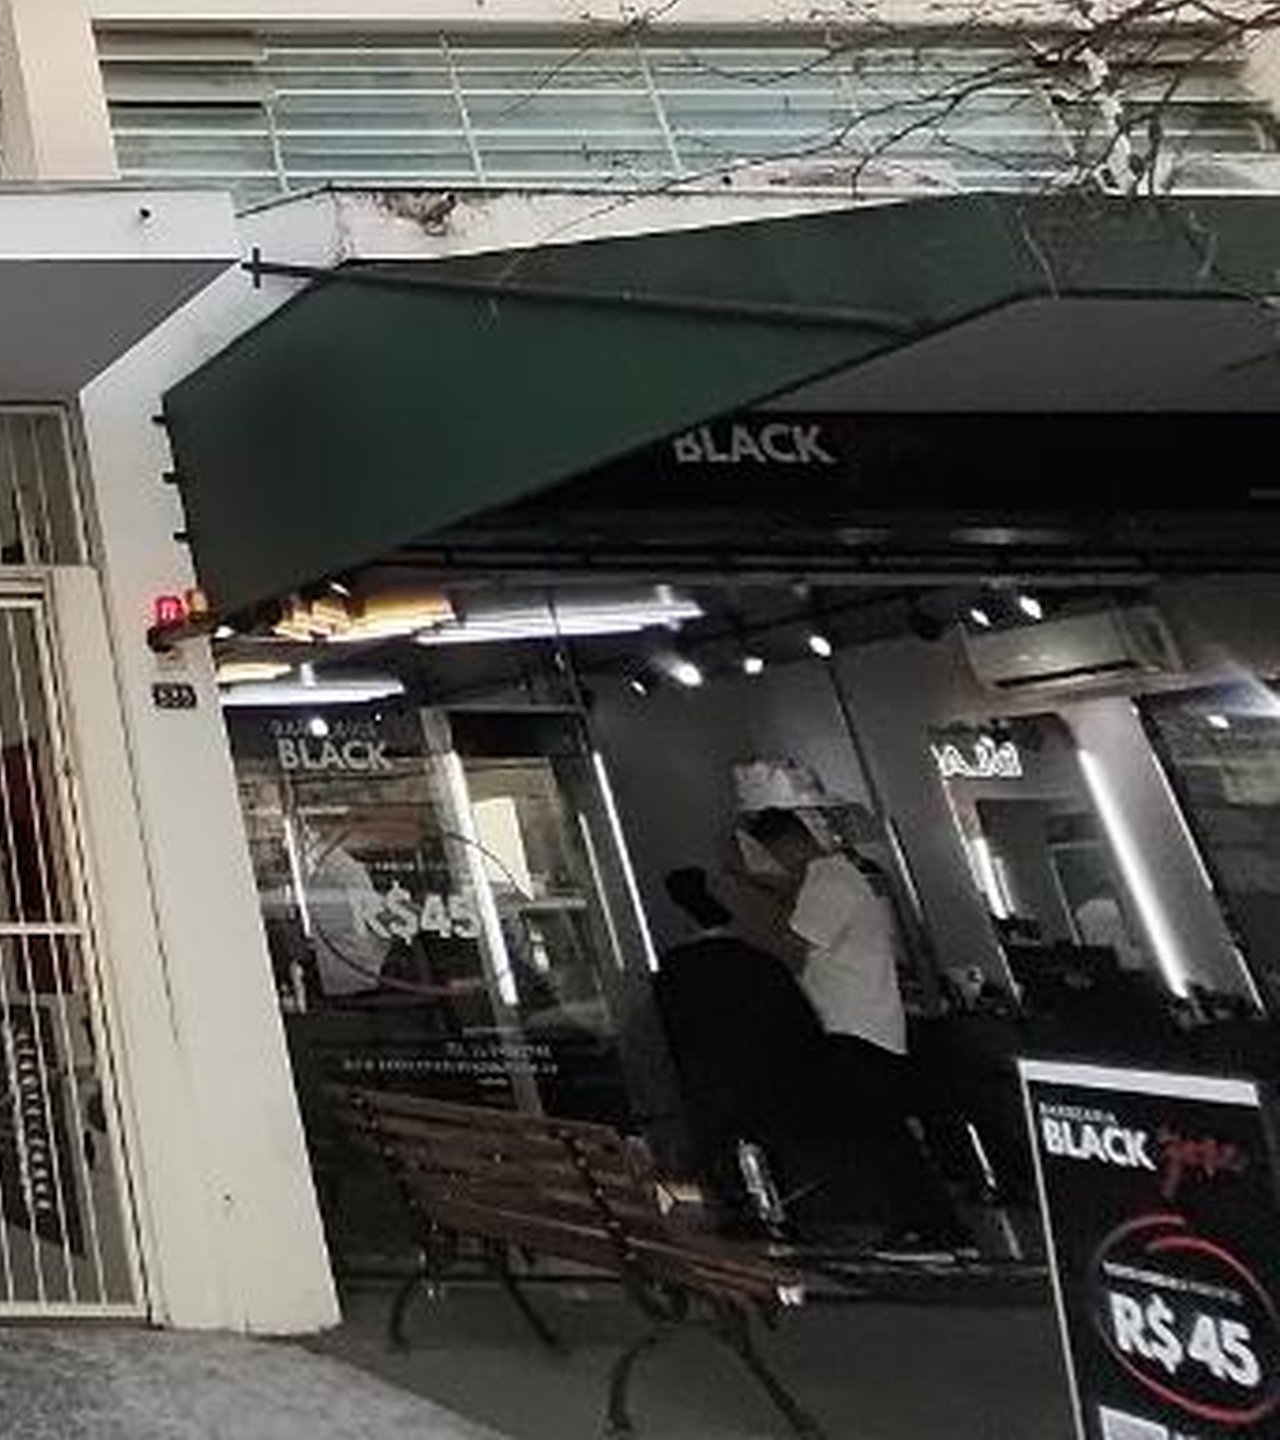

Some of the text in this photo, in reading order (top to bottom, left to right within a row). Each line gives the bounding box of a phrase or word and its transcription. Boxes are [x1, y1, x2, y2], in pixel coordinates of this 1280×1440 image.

[674, 422, 838, 464] BLACK
[278, 738, 393, 771] BLACK
[1042, 1116, 1158, 1171] BLACK
